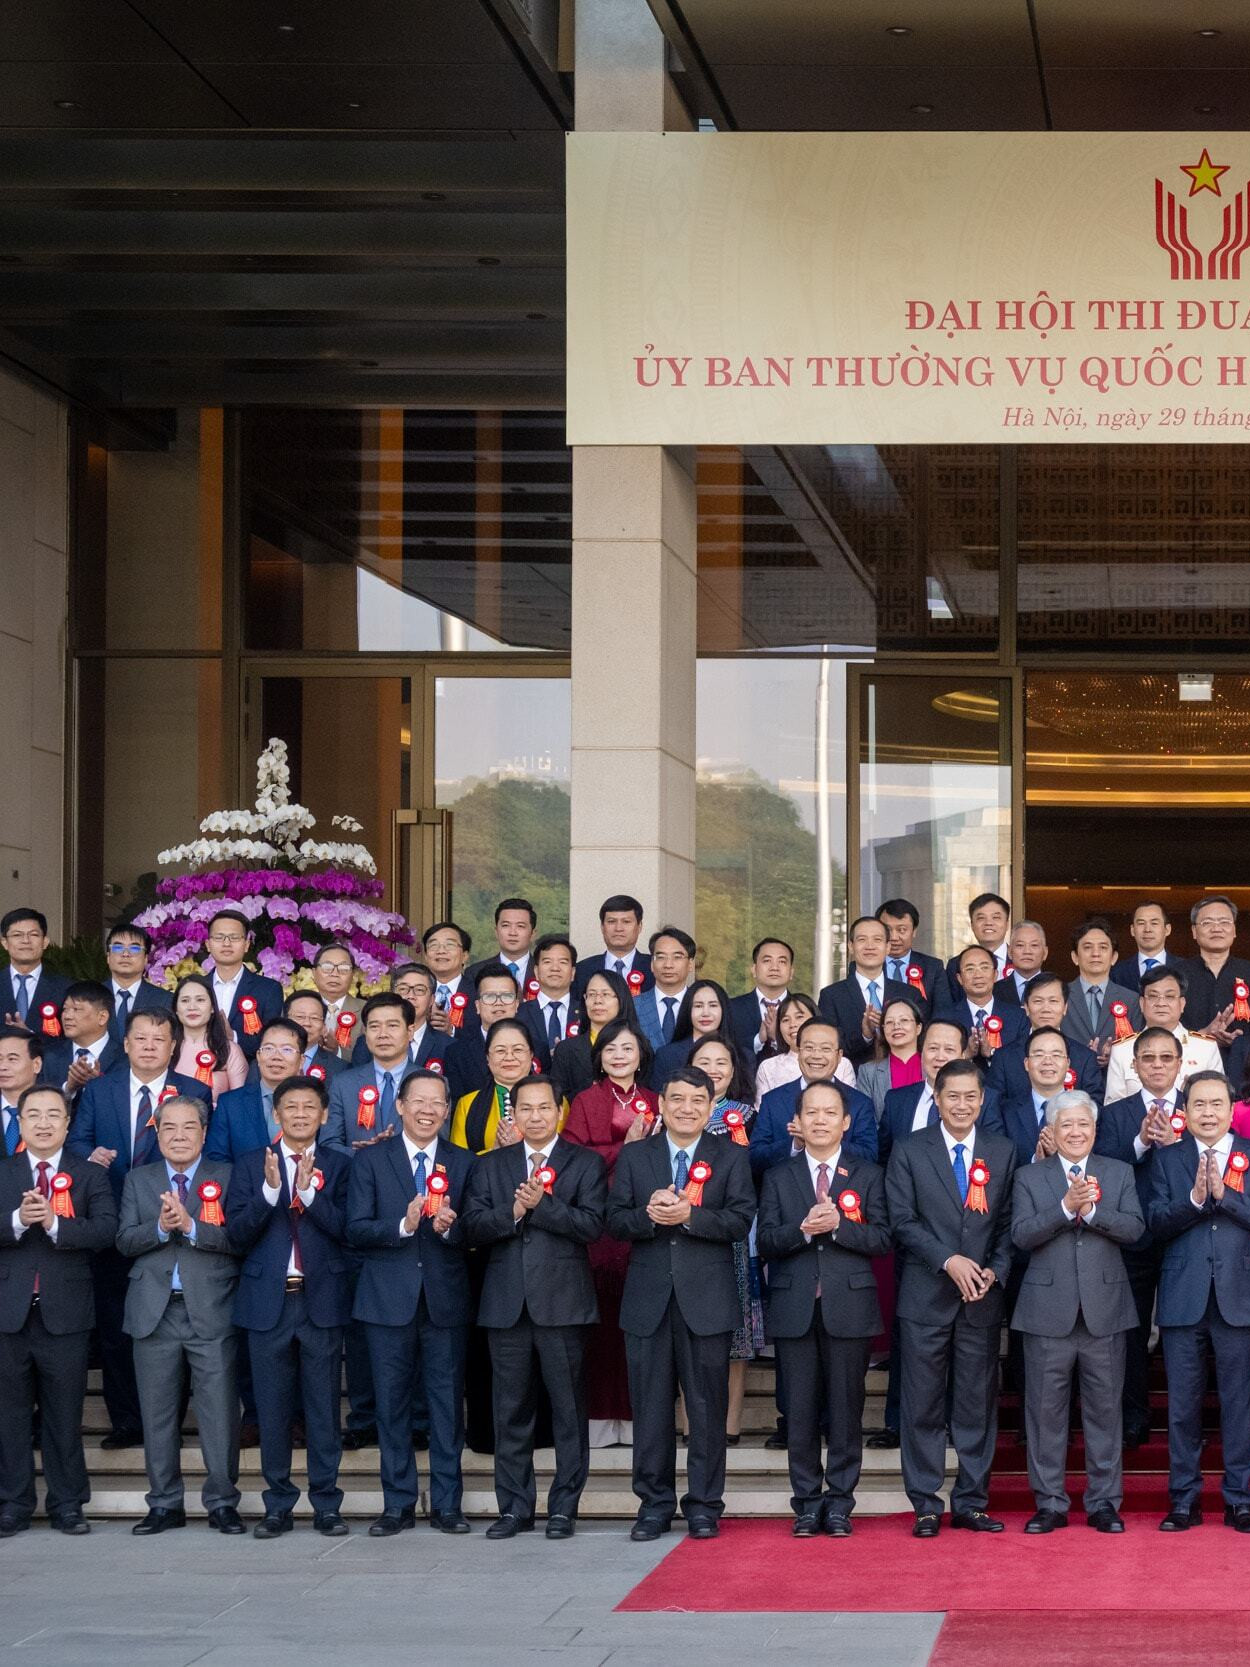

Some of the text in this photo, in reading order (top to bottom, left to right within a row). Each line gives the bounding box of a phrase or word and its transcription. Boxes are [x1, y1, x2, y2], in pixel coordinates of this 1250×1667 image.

[905, 300, 982, 339] ĐẠI
[996, 290, 1075, 340] HỘI
[1088, 300, 1165, 330] THI
[633, 343, 693, 387] ỦY
[704, 356, 794, 387] BAN
[806, 343, 995, 388] THƯỜNG
[1006, 356, 1067, 395] VỤ
[1079, 342, 1203, 394] QUỐC
[1002, 407, 1035, 427] Hà
[1042, 407, 1088, 431] Nội,
[1096, 408, 1152, 428] ngày
[1158, 407, 1186, 427] 29
